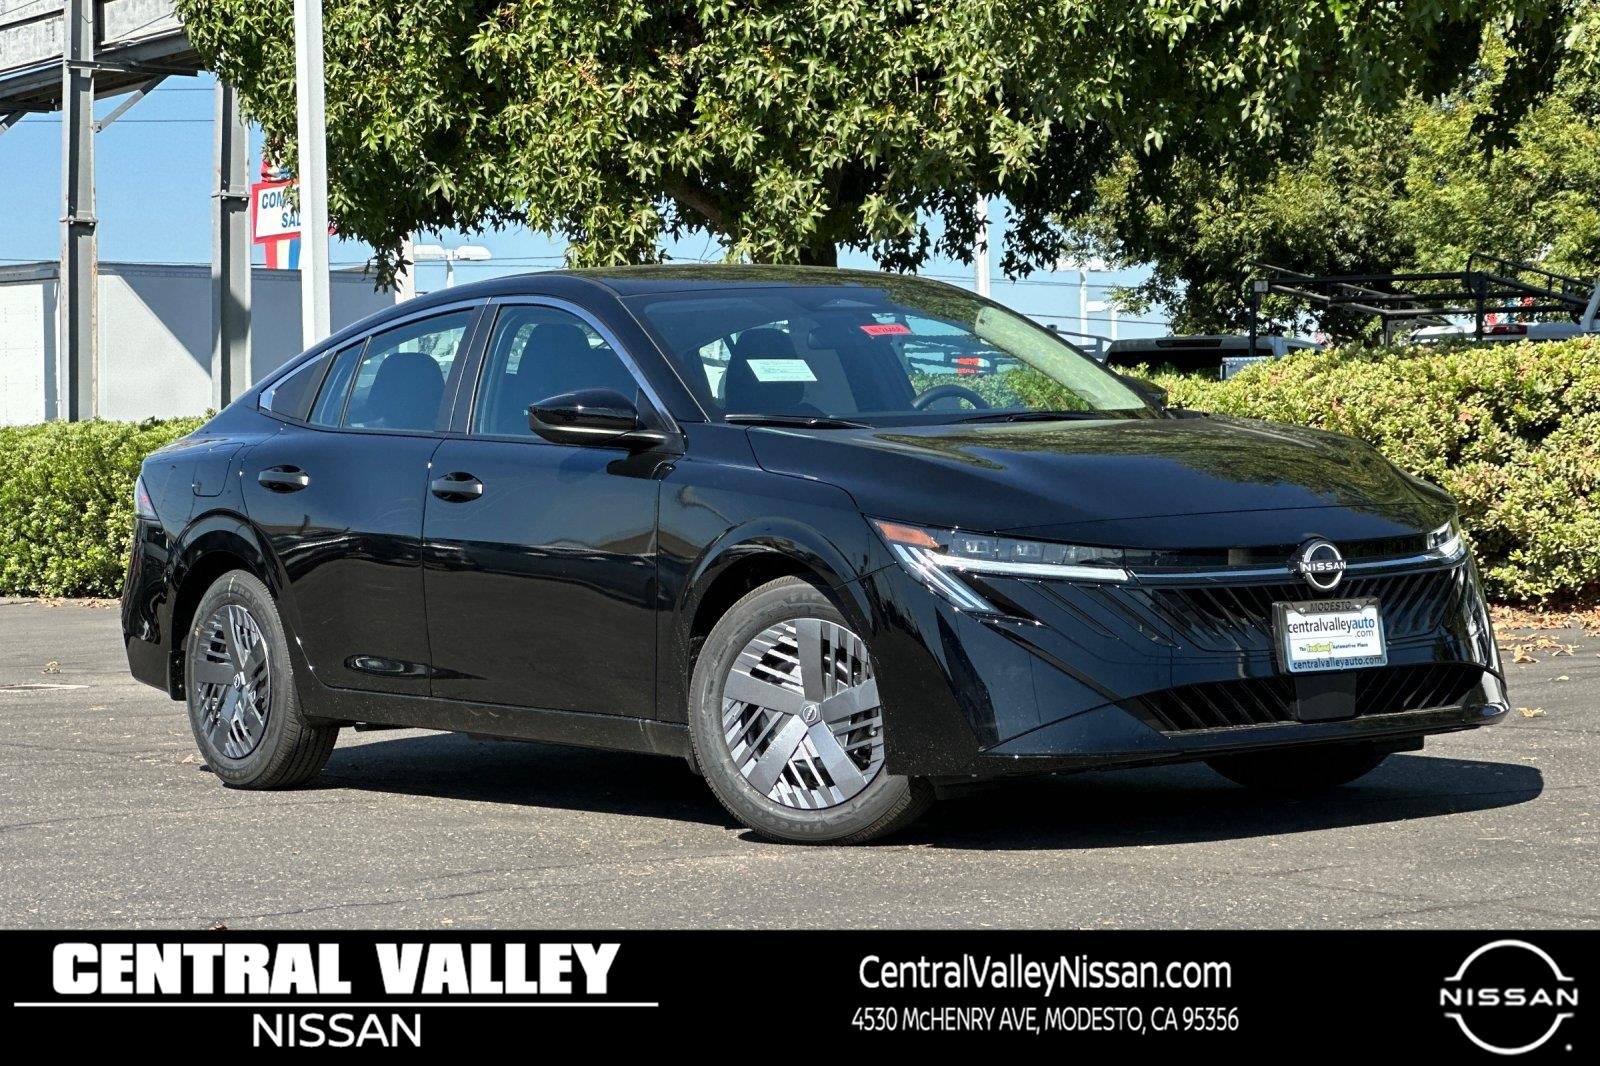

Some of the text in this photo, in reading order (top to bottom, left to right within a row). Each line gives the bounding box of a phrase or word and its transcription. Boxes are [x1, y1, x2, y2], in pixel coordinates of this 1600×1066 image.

[281, 211, 301, 228] SAL
[1302, 561, 1346, 571] NISSAN
[1310, 601, 1352, 612] MODESTO
[1288, 617, 1375, 634] centralvalleyauto
[1293, 656, 1382, 670] centralvalleyauto.com
